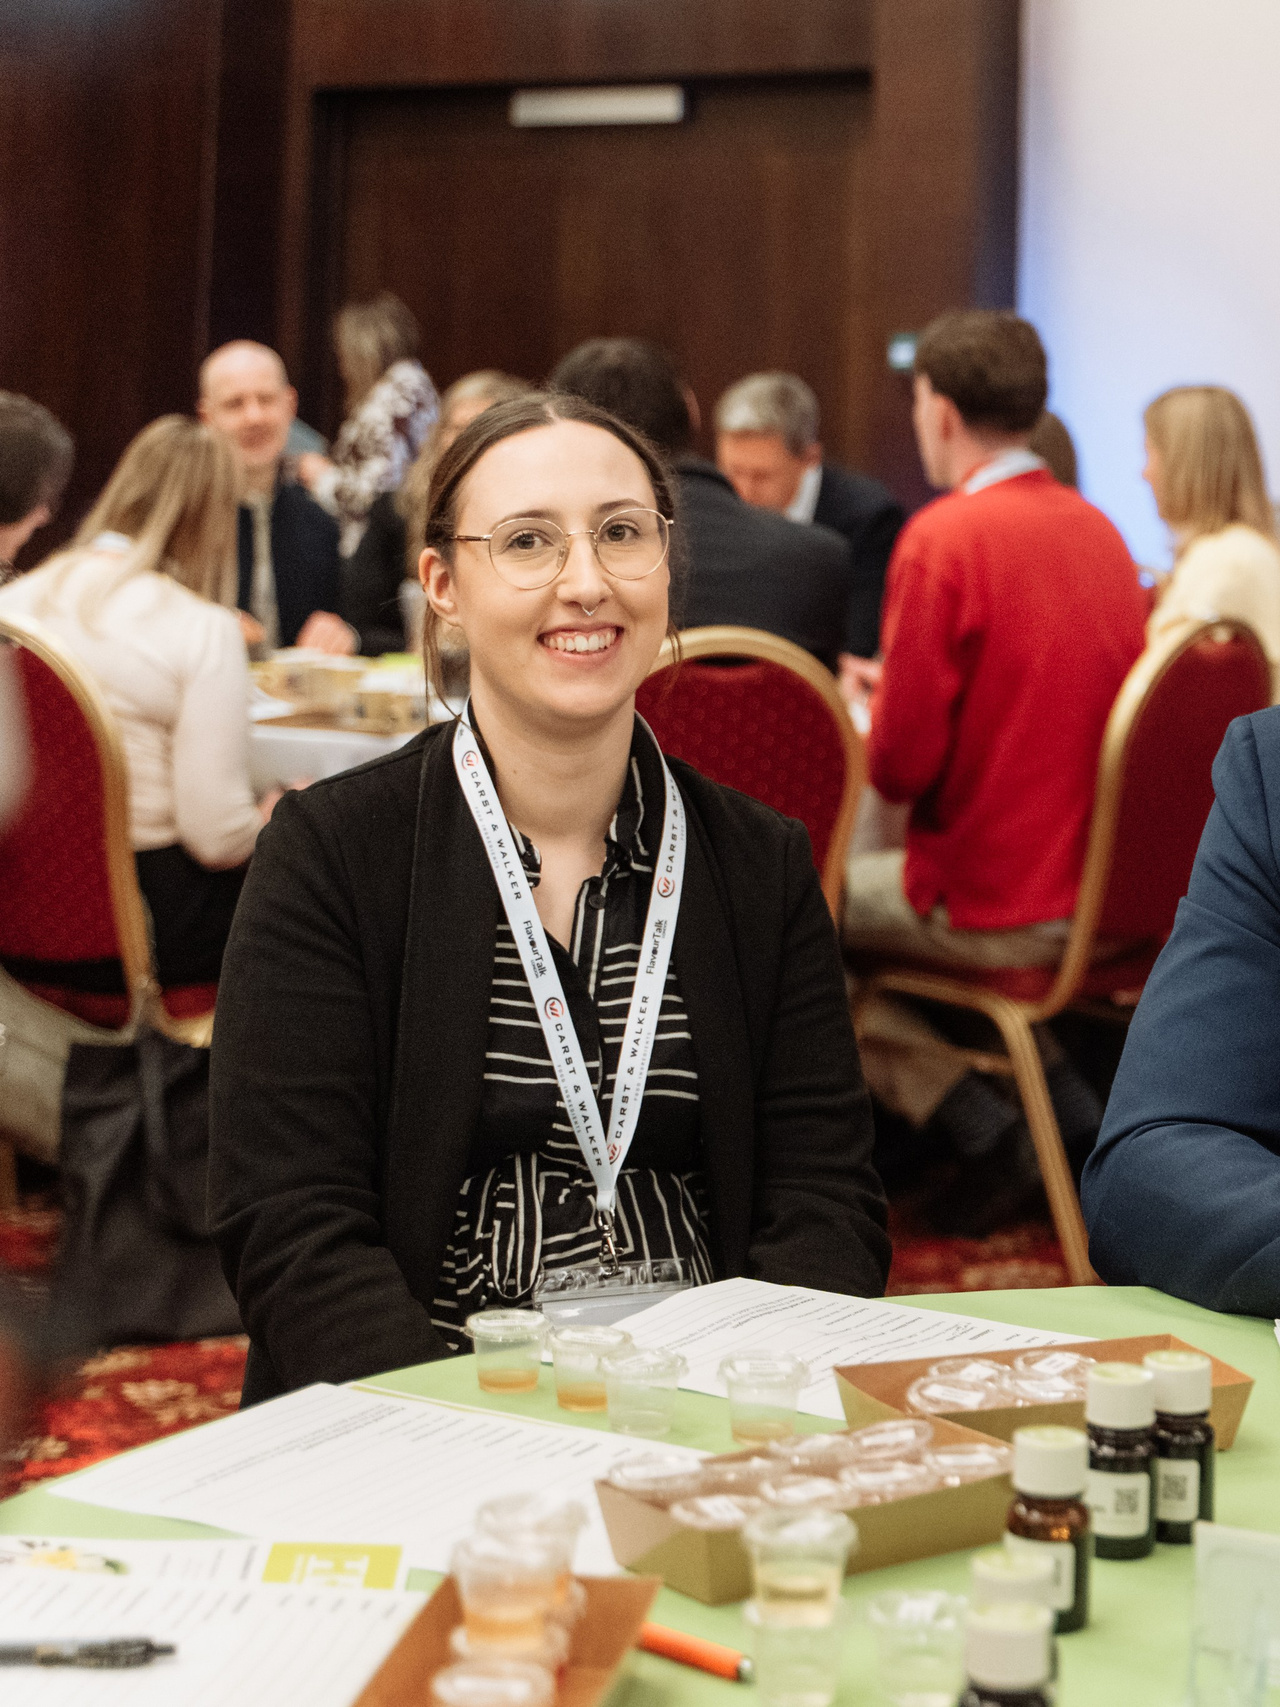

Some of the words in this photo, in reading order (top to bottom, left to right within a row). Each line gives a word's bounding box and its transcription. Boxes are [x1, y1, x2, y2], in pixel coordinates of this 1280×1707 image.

[471, 771, 494, 816] CARST
[491, 823, 499, 832] &
[497, 838, 522, 901] WALKER
[666, 824, 678, 874] CARST
[523, 920, 547, 978] FlavourTalk
[646, 919, 664, 975] FlavourTalk
[555, 1023, 577, 1075] CARST
[573, 1084, 582, 1094] &
[578, 1101, 602, 1166] WALKER
[615, 1084, 631, 1139] CARST
[627, 1066, 635, 1076] &
[631, 995, 650, 1058] WALKER
